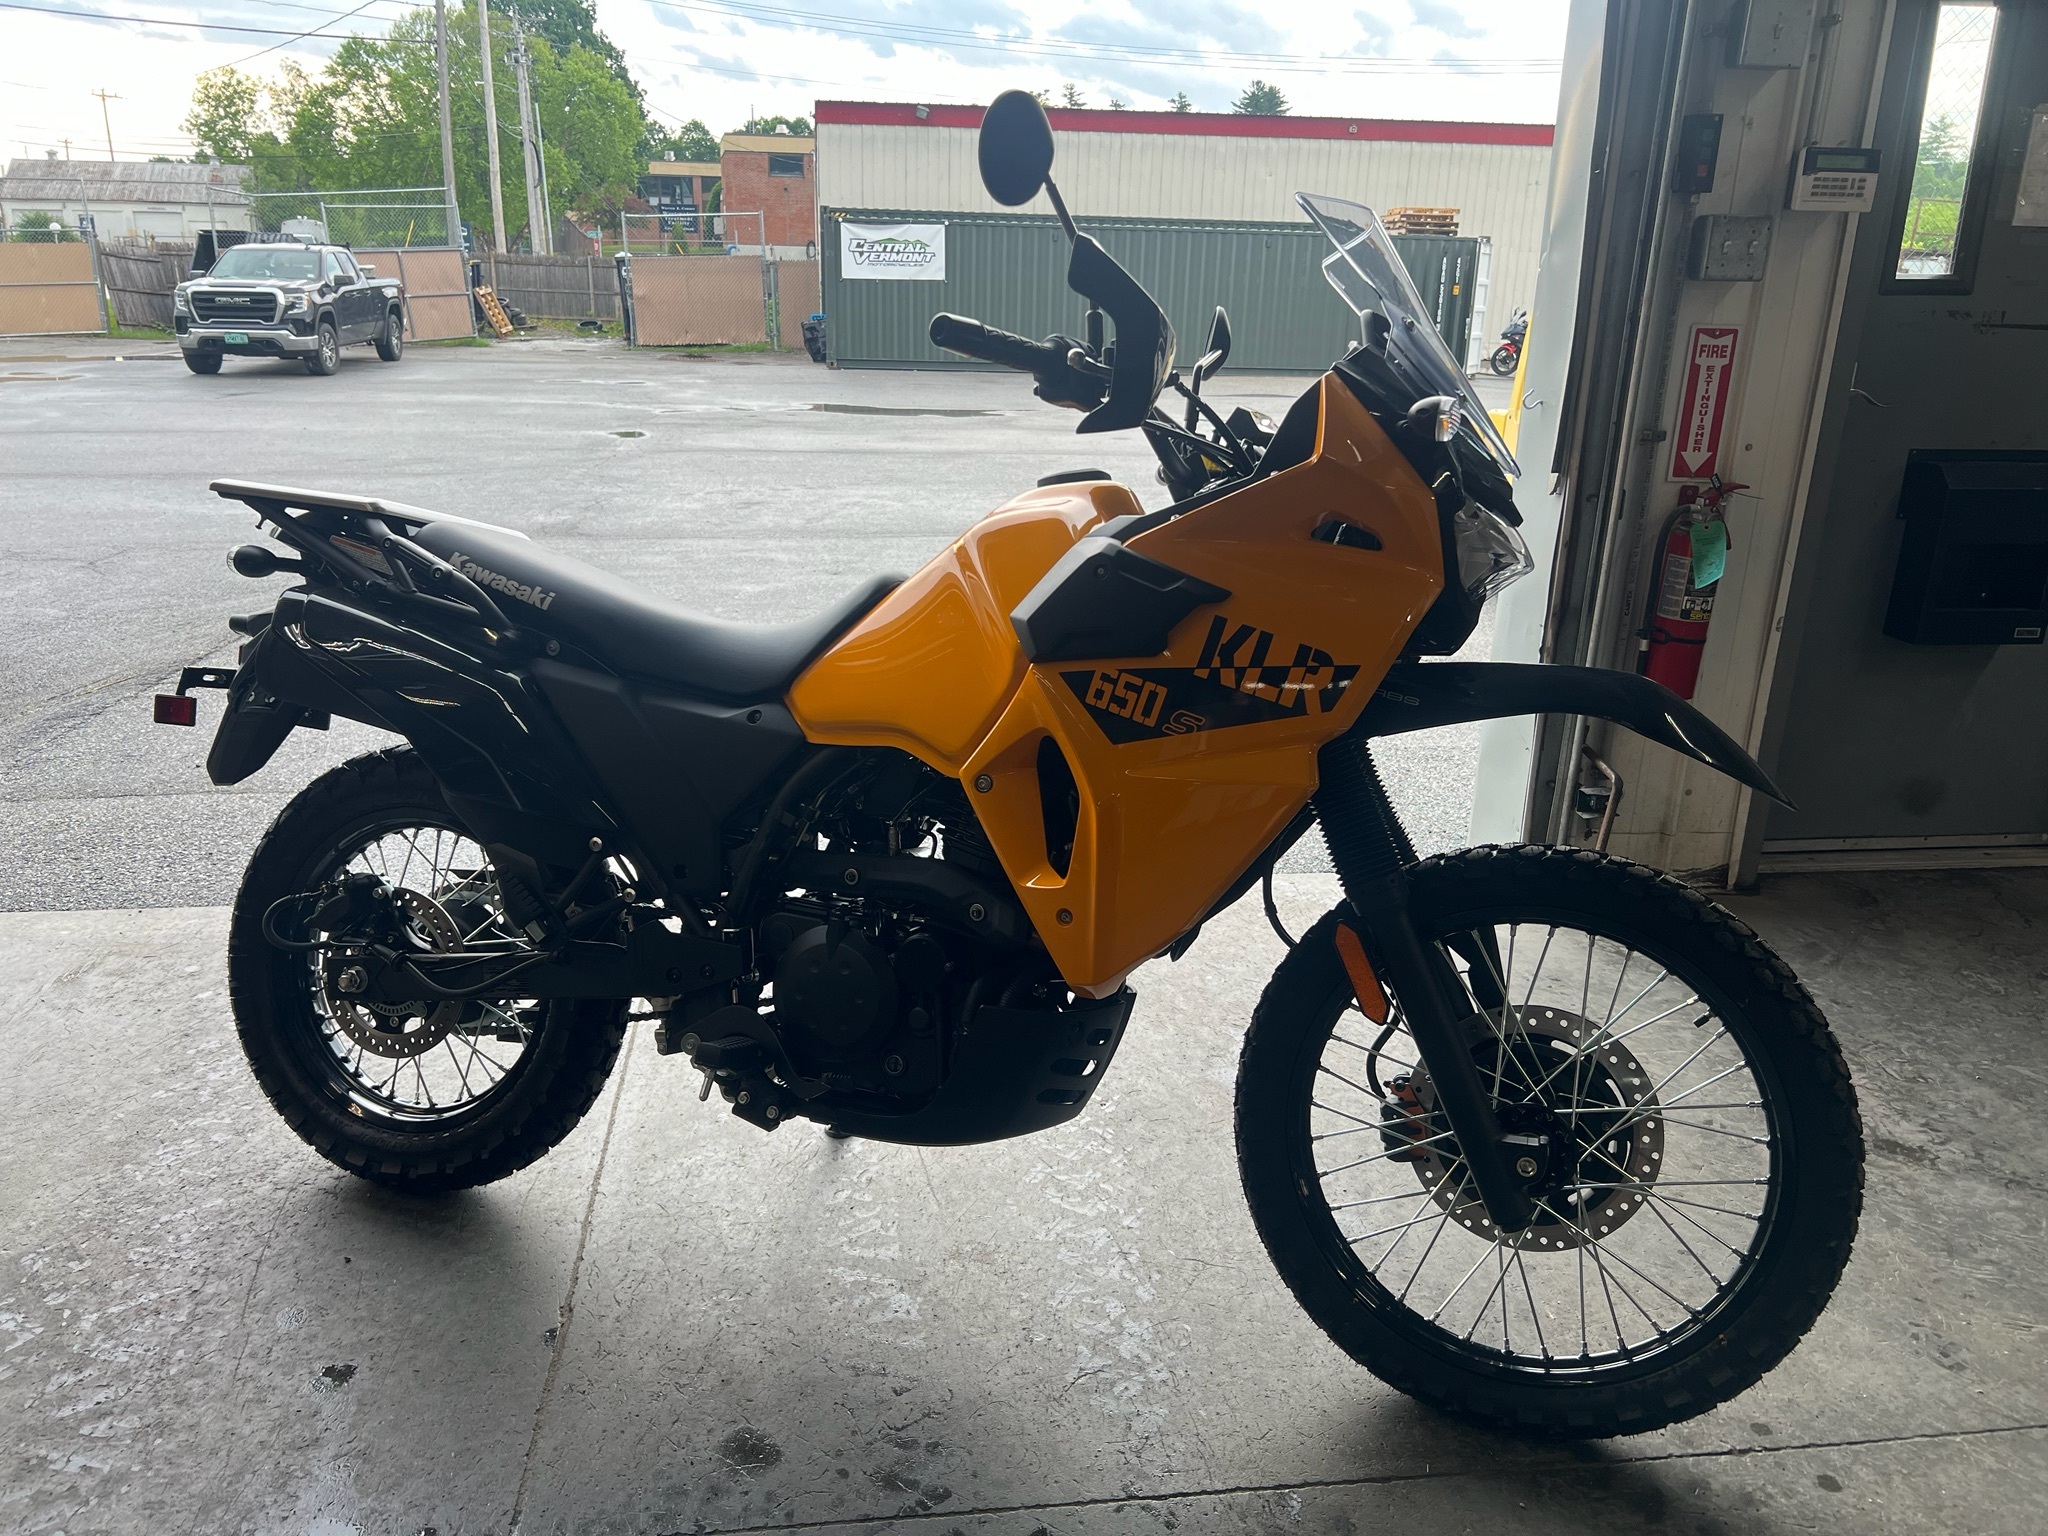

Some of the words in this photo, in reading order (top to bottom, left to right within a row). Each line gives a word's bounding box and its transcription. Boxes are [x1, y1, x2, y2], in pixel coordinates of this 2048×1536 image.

[848, 238, 926, 252] CENTRAL
[853, 252, 936, 265] VERMONT
[1698, 344, 1728, 358] FIRE
[1692, 366, 1715, 452] EXTINGUISHER
[449, 552, 556, 611] Kawasaki
[1193, 614, 1334, 714] KLR
[1086, 669, 1168, 728] 650
